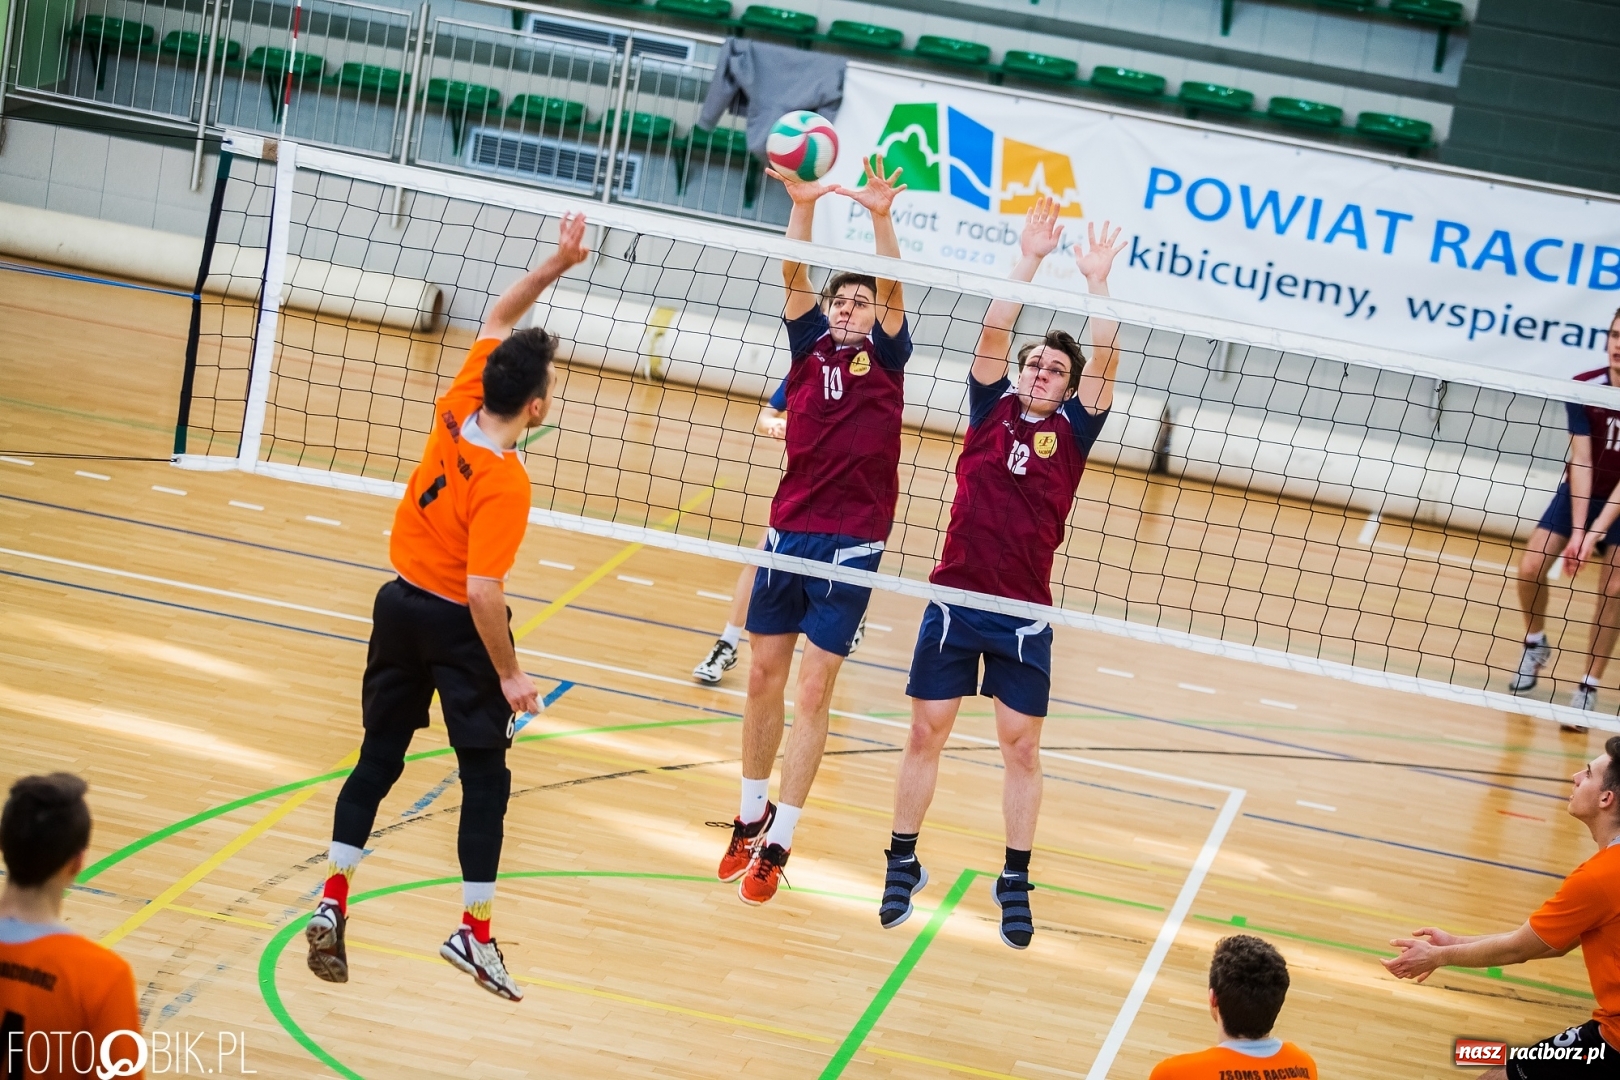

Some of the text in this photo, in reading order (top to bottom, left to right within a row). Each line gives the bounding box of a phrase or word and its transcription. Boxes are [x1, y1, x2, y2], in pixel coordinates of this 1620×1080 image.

[1143, 167, 1620, 292] POWIAT RACIB
[1128, 236, 1377, 320] kibicujemy,
[822, 366, 843, 400] 10
[1007, 439, 1030, 475] 12
